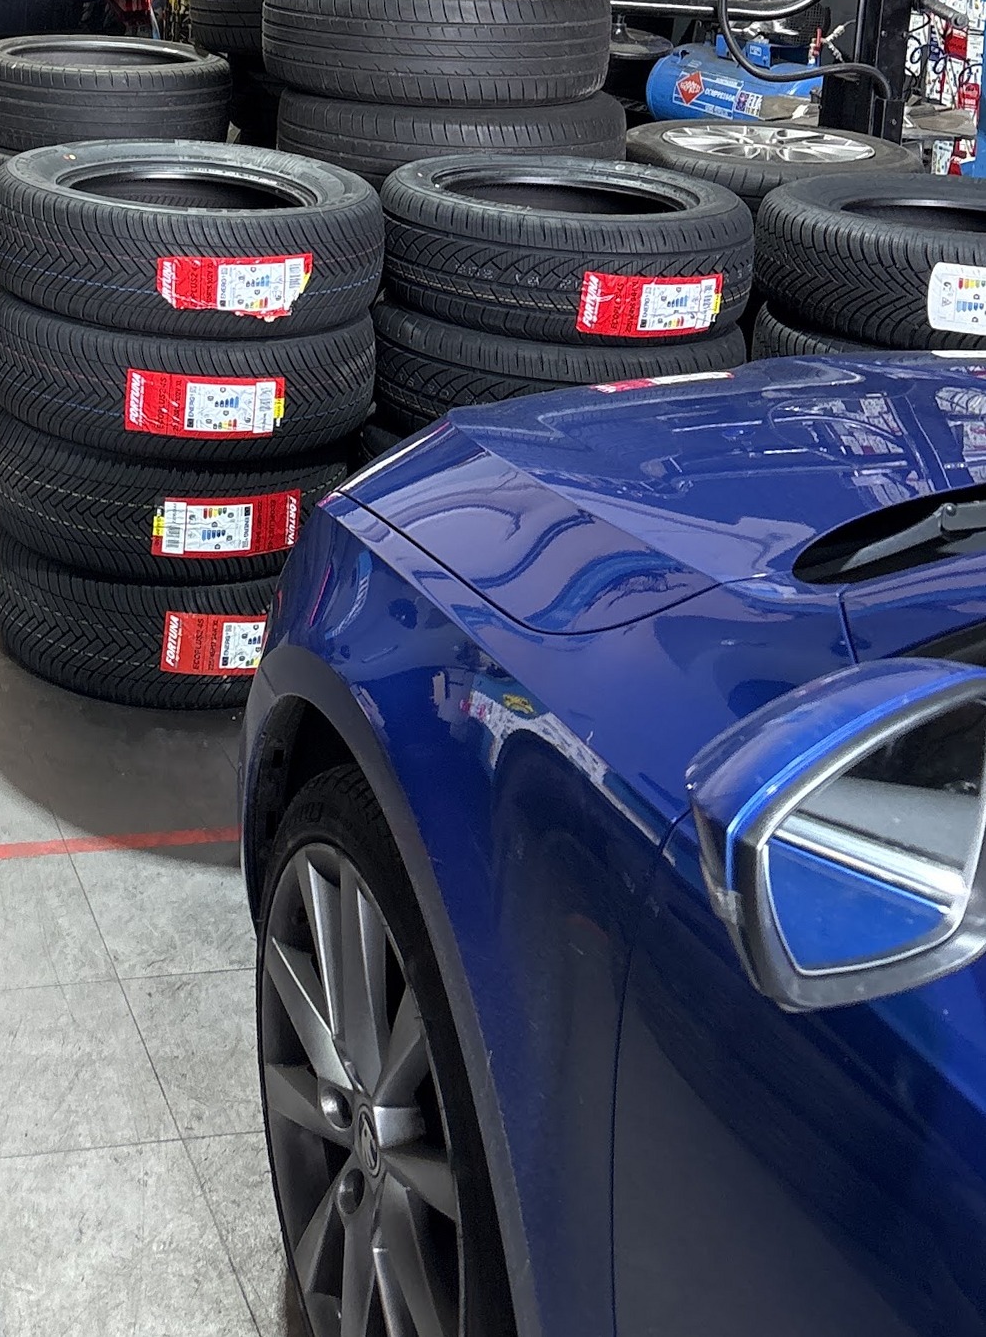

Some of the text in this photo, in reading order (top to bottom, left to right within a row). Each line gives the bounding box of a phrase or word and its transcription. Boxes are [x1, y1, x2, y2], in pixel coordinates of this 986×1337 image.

[130, 372, 143, 425] FORTUNA
[285, 495, 298, 545] FORTUNA
[166, 615, 182, 667] FORTUNA
